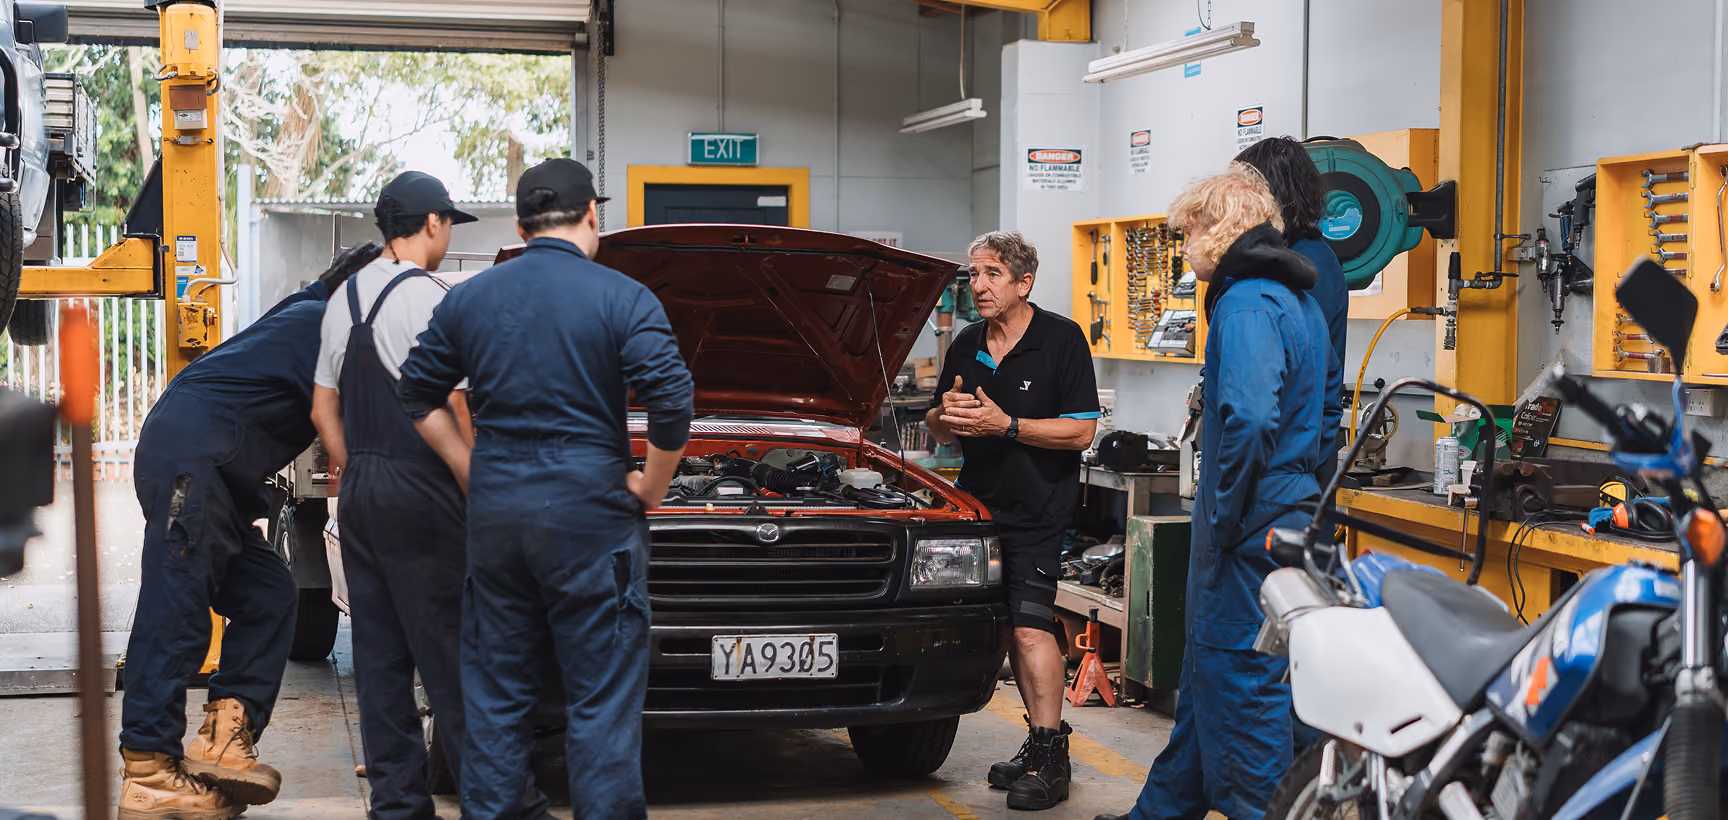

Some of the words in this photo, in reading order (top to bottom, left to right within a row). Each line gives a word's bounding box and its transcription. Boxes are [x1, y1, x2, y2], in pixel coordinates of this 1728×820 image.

[704, 138, 744, 159] EXIT
[1035, 152, 1073, 161] DANGER
[1040, 164, 1080, 172] FLAMMABLE
[719, 640, 834, 675] YA9305
